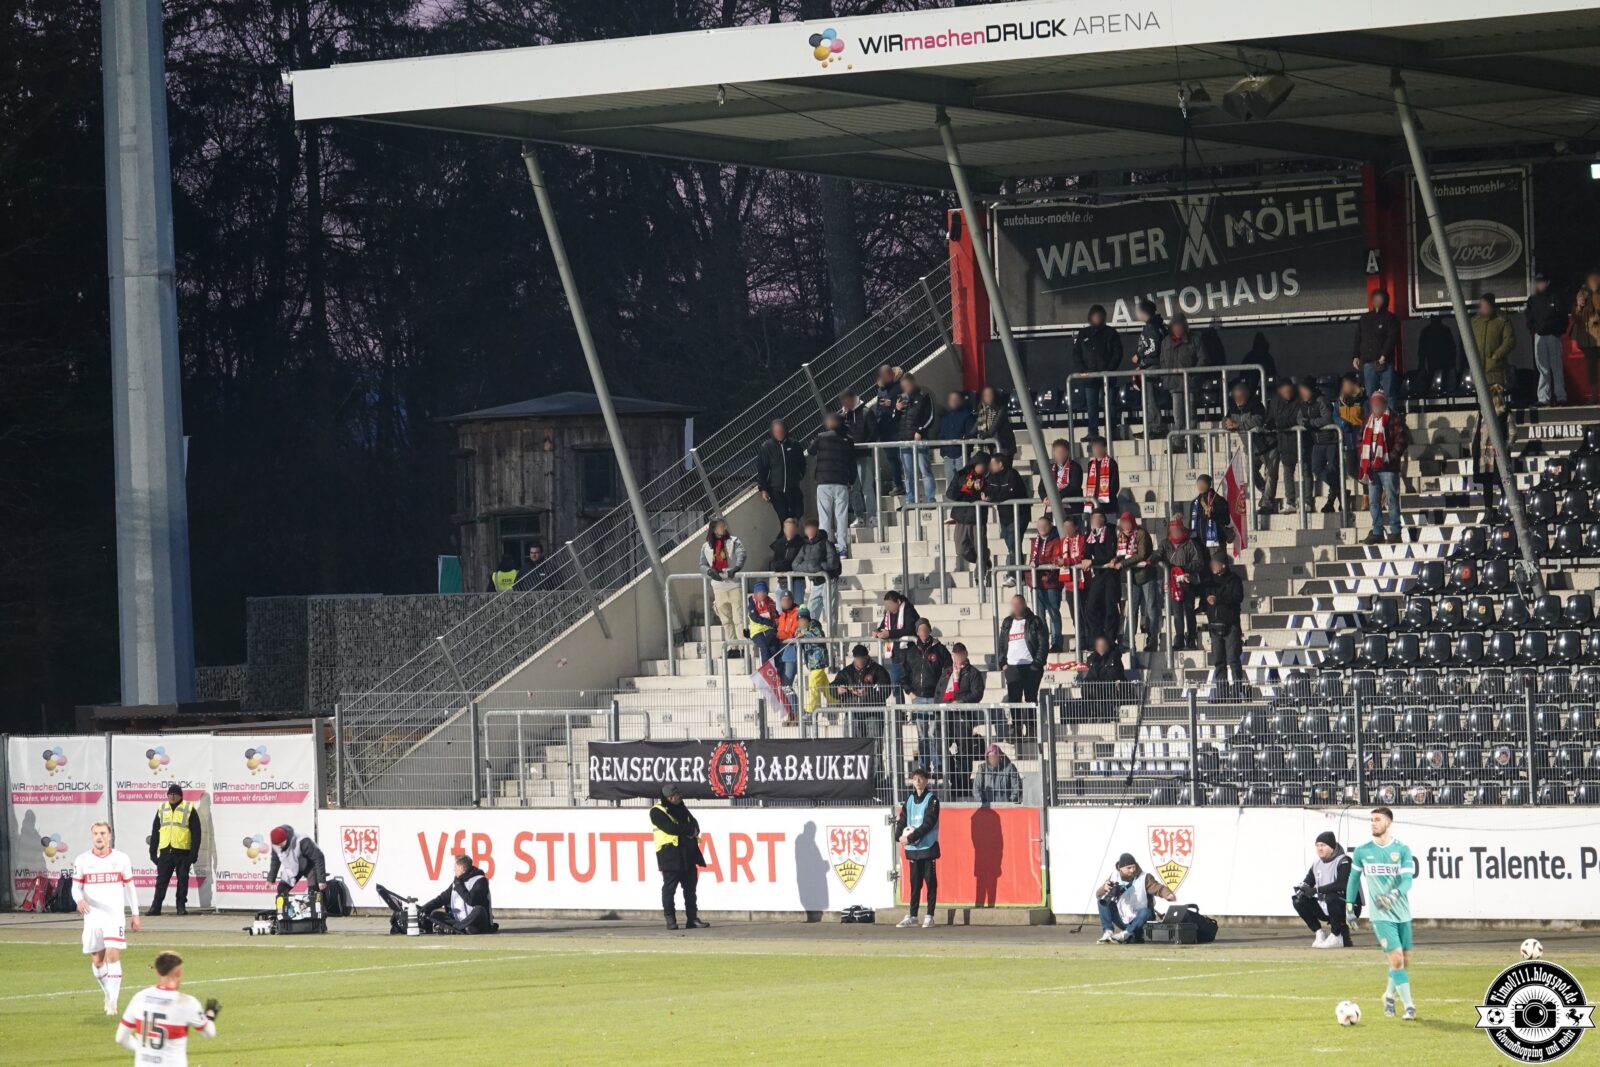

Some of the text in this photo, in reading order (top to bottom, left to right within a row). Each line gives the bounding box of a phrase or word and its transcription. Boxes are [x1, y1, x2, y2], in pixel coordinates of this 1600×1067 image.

[858, 11, 1161, 54] WIRmachenDRUCK ARENA
[1035, 190, 1360, 280] WALTER MÖHLE
[1366, 250, 1379, 273] A
[1112, 268, 1300, 324] ATOHAUS
[1528, 424, 1583, 439] AUTOHAUS
[589, 755, 707, 784] REMSECKER
[754, 755, 870, 783] RABAUKEN
[514, 831, 786, 883] STUTTART
[1427, 846, 1463, 879] für
[1469, 846, 1572, 880] Talente.
[1580, 846, 1600, 880] P
[142, 1010, 167, 1050] 15
